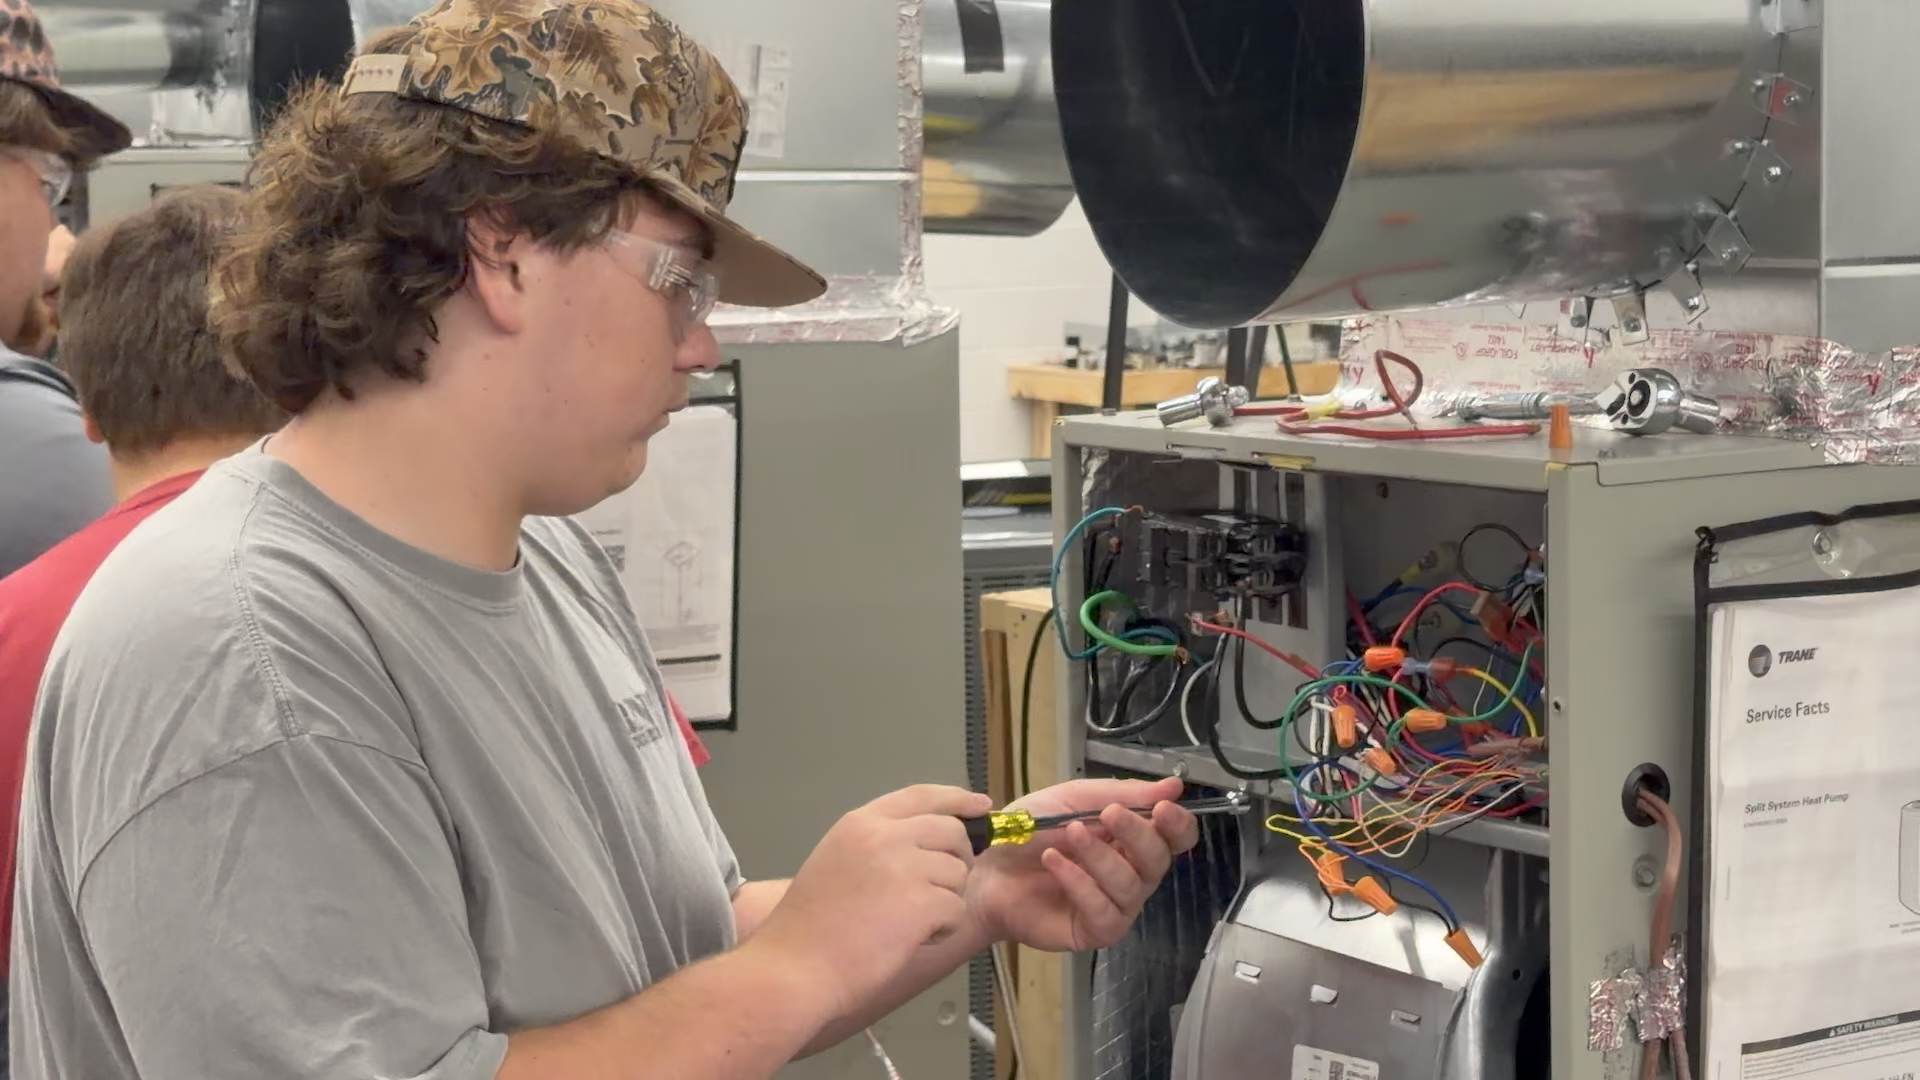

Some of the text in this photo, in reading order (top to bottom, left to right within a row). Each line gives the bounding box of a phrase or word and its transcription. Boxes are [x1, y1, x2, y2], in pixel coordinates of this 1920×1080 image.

[1778, 647, 1818, 664] TRANE
[1746, 701, 1830, 723] Service Facts
[1745, 793, 1849, 815] Split System Heat Pump
[1836, 1022, 1864, 1035] SAFETY
